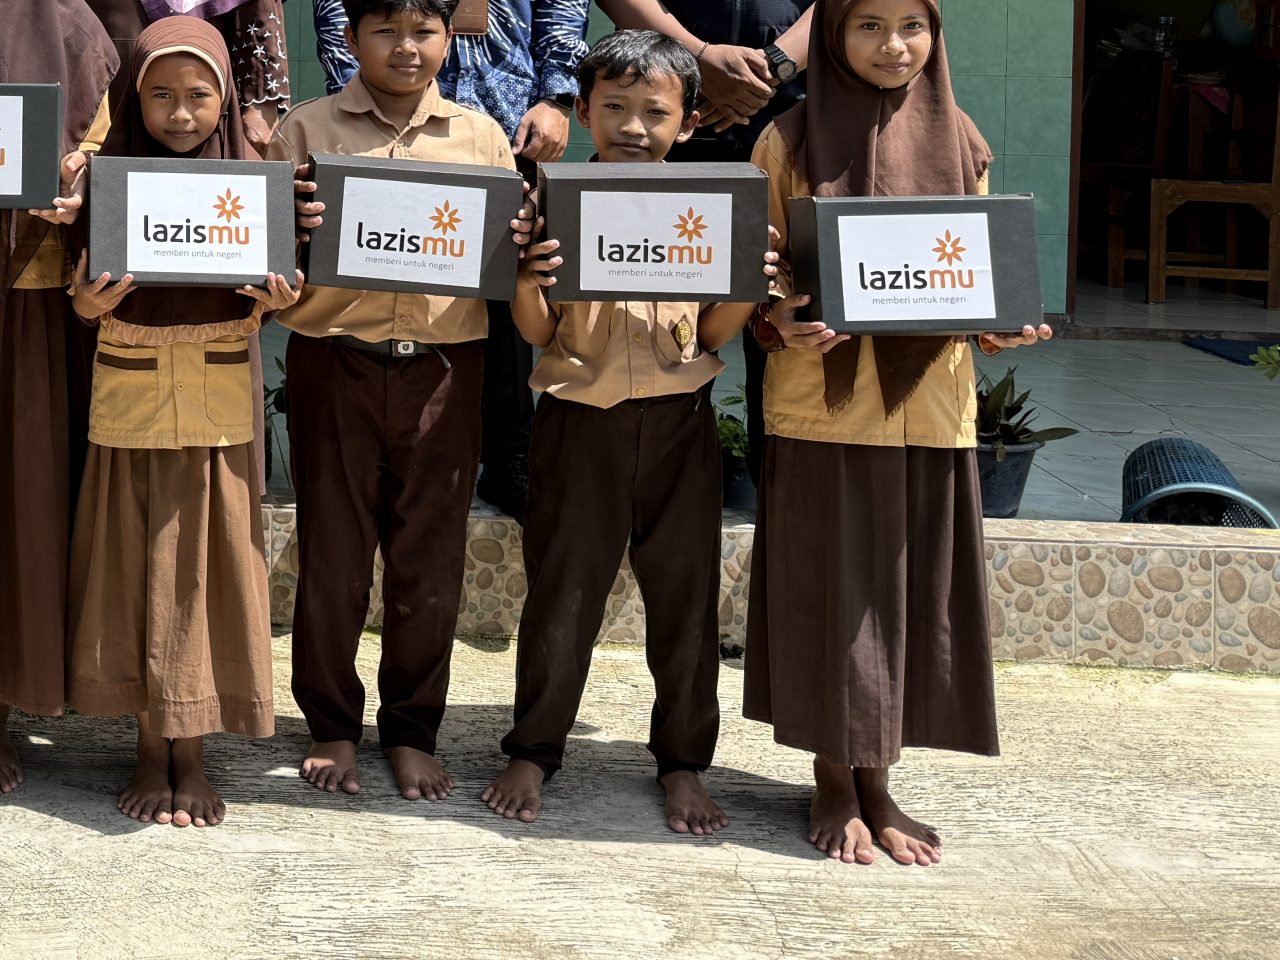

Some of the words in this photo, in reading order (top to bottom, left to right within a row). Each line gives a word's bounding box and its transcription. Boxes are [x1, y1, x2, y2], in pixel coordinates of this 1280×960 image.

[143, 214, 249, 245] lazismu
[356, 221, 464, 257] lazismu
[153, 249, 190, 257] memberi
[191, 250, 215, 258] untuk
[216, 251, 241, 260] negeri
[597, 234, 712, 264] lazismu
[365, 256, 402, 265] memberi
[403, 260, 426, 268] untuk
[428, 262, 454, 271] negeri
[608, 268, 647, 276] memberi
[649, 269, 673, 277] untuk
[675, 271, 702, 280] negeri
[858, 261, 974, 290] lazismu
[872, 296, 911, 305] memberi
[912, 295, 937, 304] untuk
[939, 296, 966, 305] negeri
